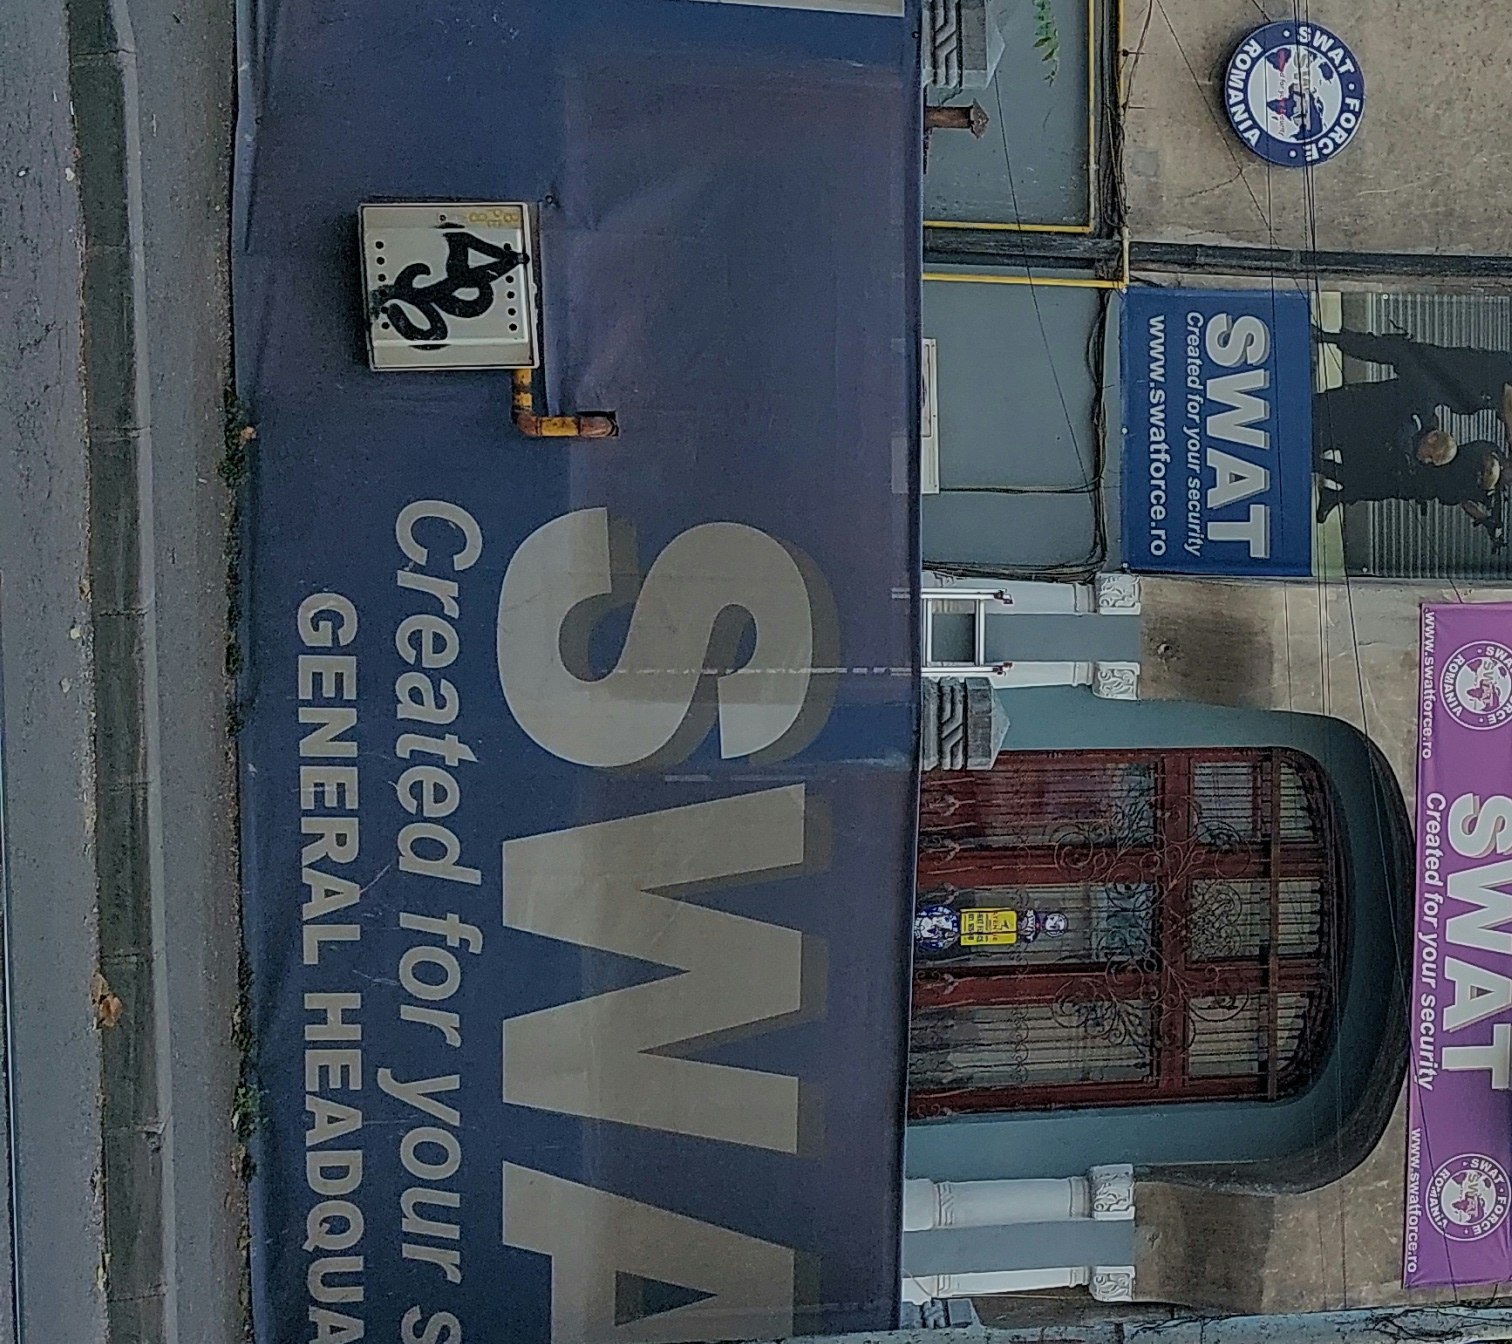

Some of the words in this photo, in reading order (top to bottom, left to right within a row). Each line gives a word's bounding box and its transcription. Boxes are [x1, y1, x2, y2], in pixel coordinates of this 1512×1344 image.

[1297, 26, 1355, 74] SWAT
[1227, 39, 1263, 148] ROMANIA
[1302, 97, 1361, 162] FORCE
[1186, 311, 1204, 388] Created
[1148, 314, 1170, 557] www.swatforce.ro
[1187, 393, 1204, 422] for
[1205, 312, 1269, 559] SWAT
[1182, 424, 1201, 474] your
[1183, 477, 1204, 557] security
[394, 499, 484, 886] Created
[1422, 612, 1436, 759] www.swatforce.ro
[1443, 654, 1466, 717] ROMANIA
[297, 592, 362, 965] GENERAL
[1424, 792, 1446, 886] Created
[1423, 892, 1444, 928] for
[399, 912, 484, 1048] for
[1417, 932, 1438, 988] your
[1414, 993, 1439, 1091] security
[376, 1067, 462, 1283] your
[1407, 1128, 1422, 1273] www.swatforce.ro
[1429, 1167, 1451, 1229] ROMANIA
[1470, 1158, 1506, 1185] SWAT
[1472, 1195, 1507, 1235] FORCE
